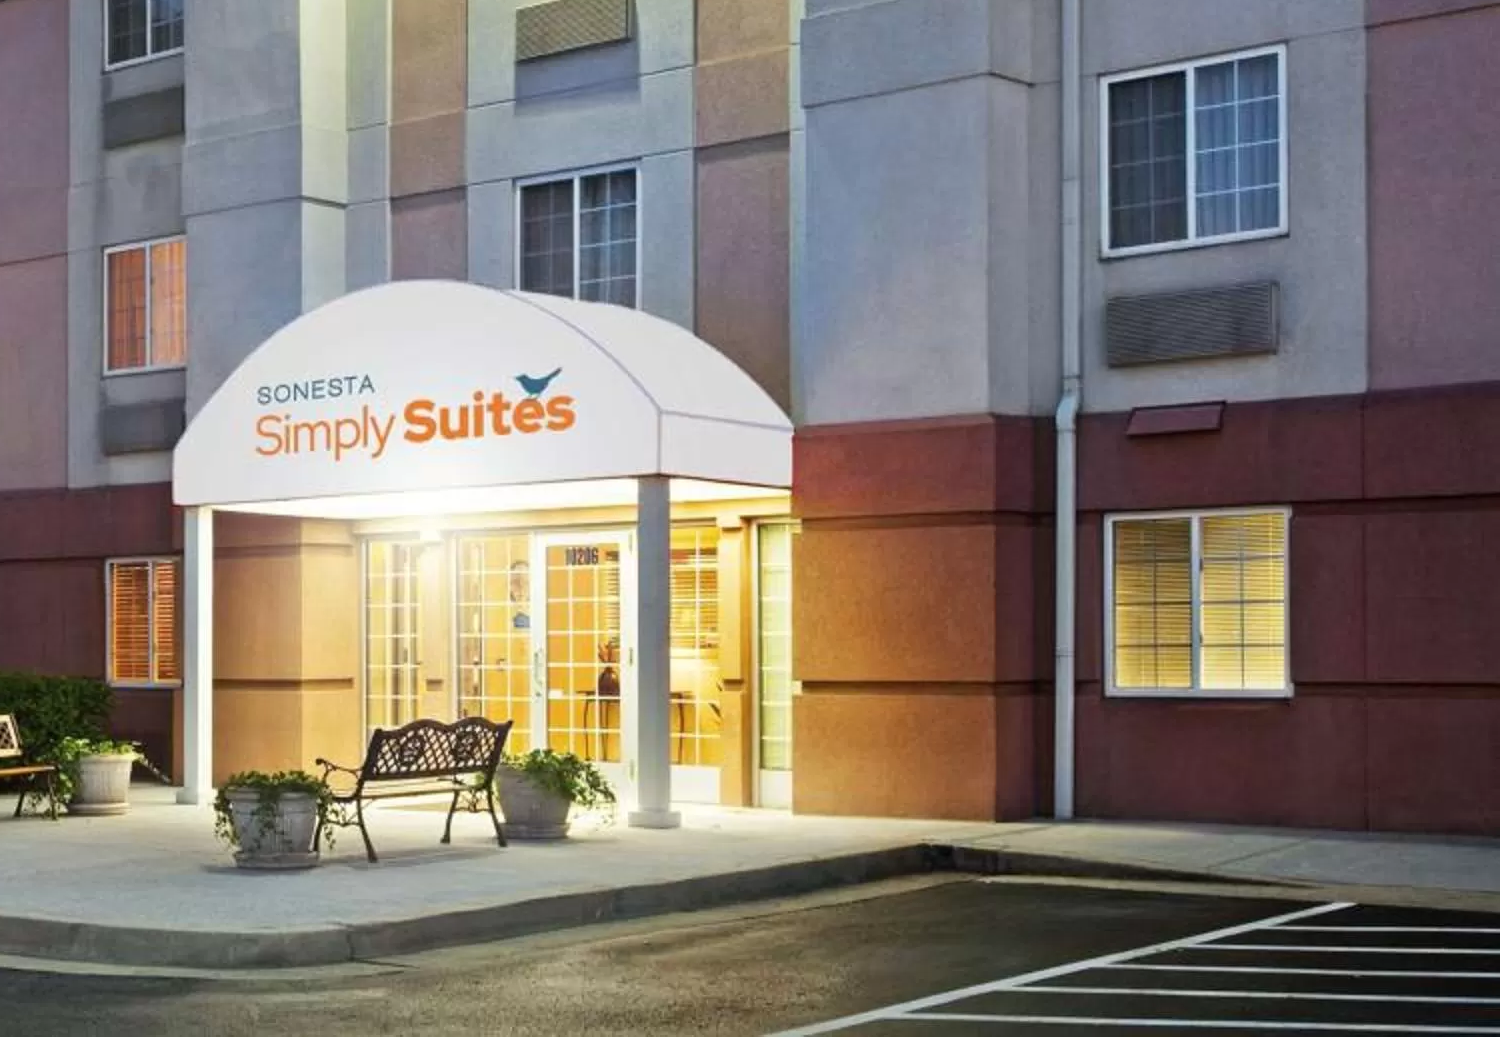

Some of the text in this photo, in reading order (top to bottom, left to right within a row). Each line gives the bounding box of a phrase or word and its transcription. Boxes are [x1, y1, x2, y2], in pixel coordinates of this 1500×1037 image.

[257, 374, 375, 404] SONESTA
[256, 391, 576, 461] Simply Suites
